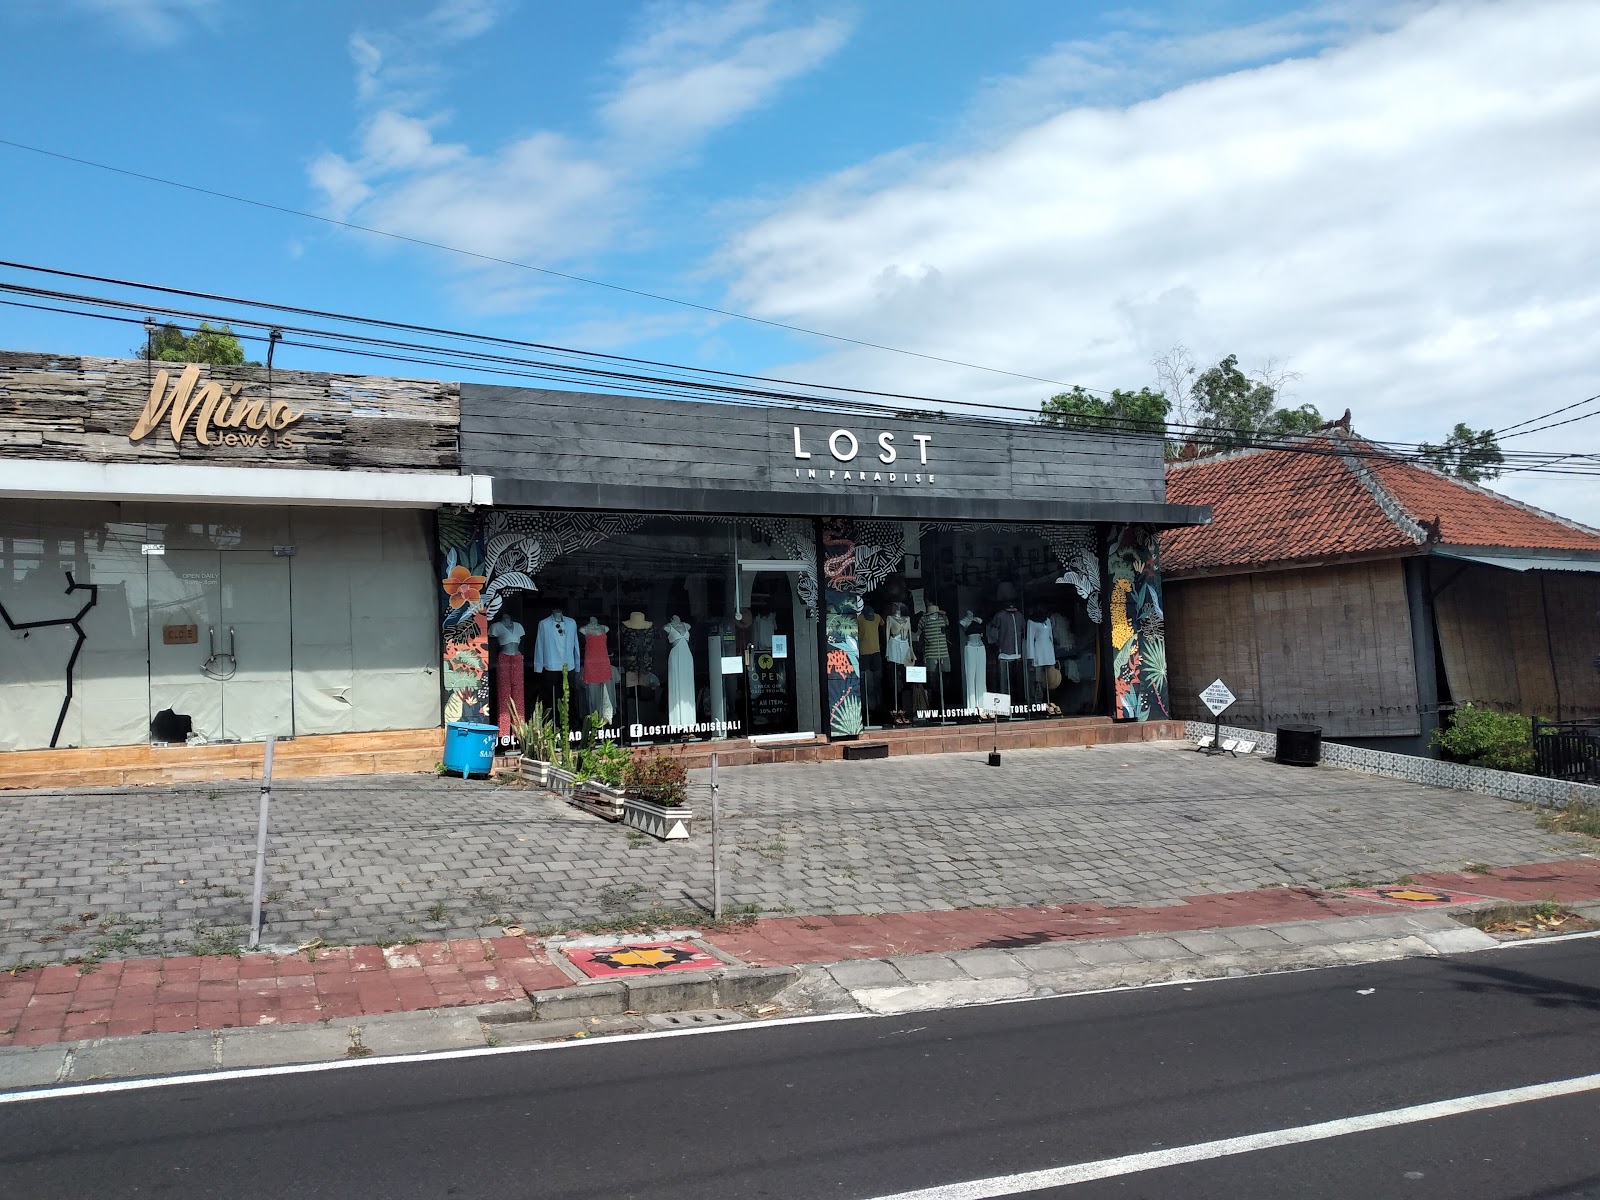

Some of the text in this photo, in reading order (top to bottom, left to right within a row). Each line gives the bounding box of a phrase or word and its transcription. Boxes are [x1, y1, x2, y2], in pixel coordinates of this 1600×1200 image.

[128, 363, 304, 446] Mino
[793, 426, 932, 465] LOST
[795, 468, 936, 484] IN PARADISE
[751, 672, 783, 681] OPEN
[916, 703, 1047, 718] WWW.LOSTINPARTORE.COM
[643, 720, 741, 736] LOSTINPARADISEBALI
